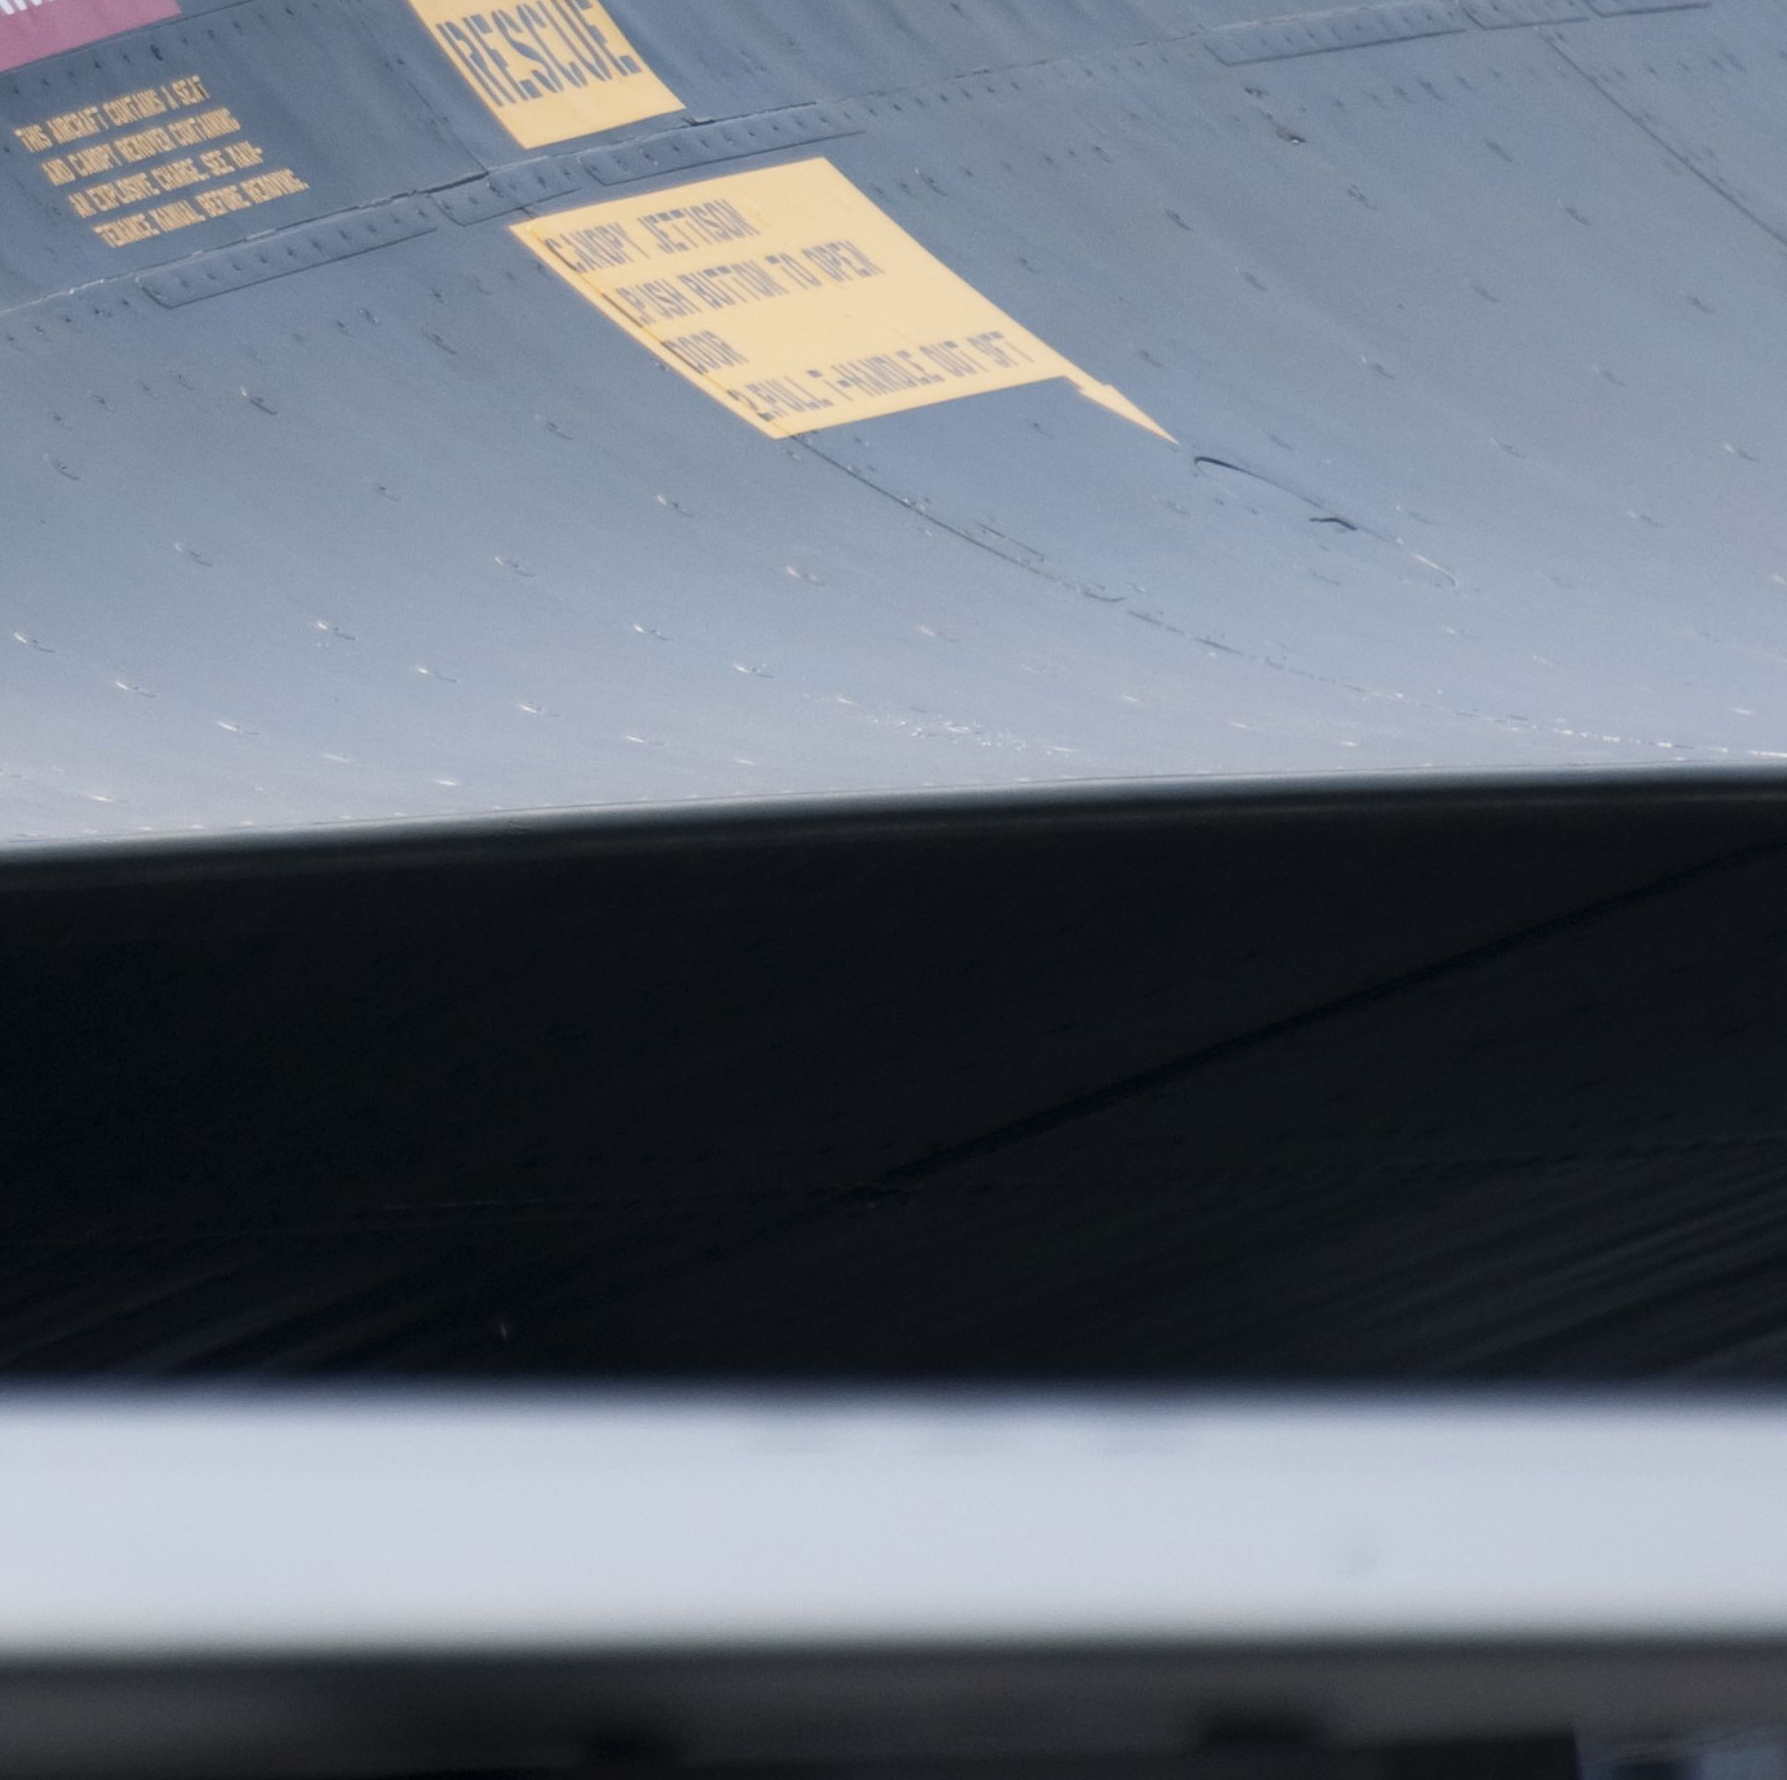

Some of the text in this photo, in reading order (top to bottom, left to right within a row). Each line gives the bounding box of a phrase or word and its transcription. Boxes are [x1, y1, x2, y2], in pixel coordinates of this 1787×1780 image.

[14, 75, 210, 152] THIS AIRCRAFT CONTAINS A SEAT
[42, 107, 241, 186] AND CANOPY REMOVER CONTAINING
[68, 192, 96, 218] AN
[86, 172, 160, 212] EXPLOSIVE
[200, 150, 235, 177] SEE
[93, 213, 161, 248] TENANCE
[195, 185, 252, 218] BEFORE
[544, 198, 762, 274] CANOPY JETTISON
[676, 259, 789, 310] BUTTON
[765, 252, 823, 291] TO
[801, 239, 884, 282] OPEN
[660, 330, 749, 376] DOOR
[806, 350, 944, 402] T-HANDLE
[920, 340, 989, 377] OUT
